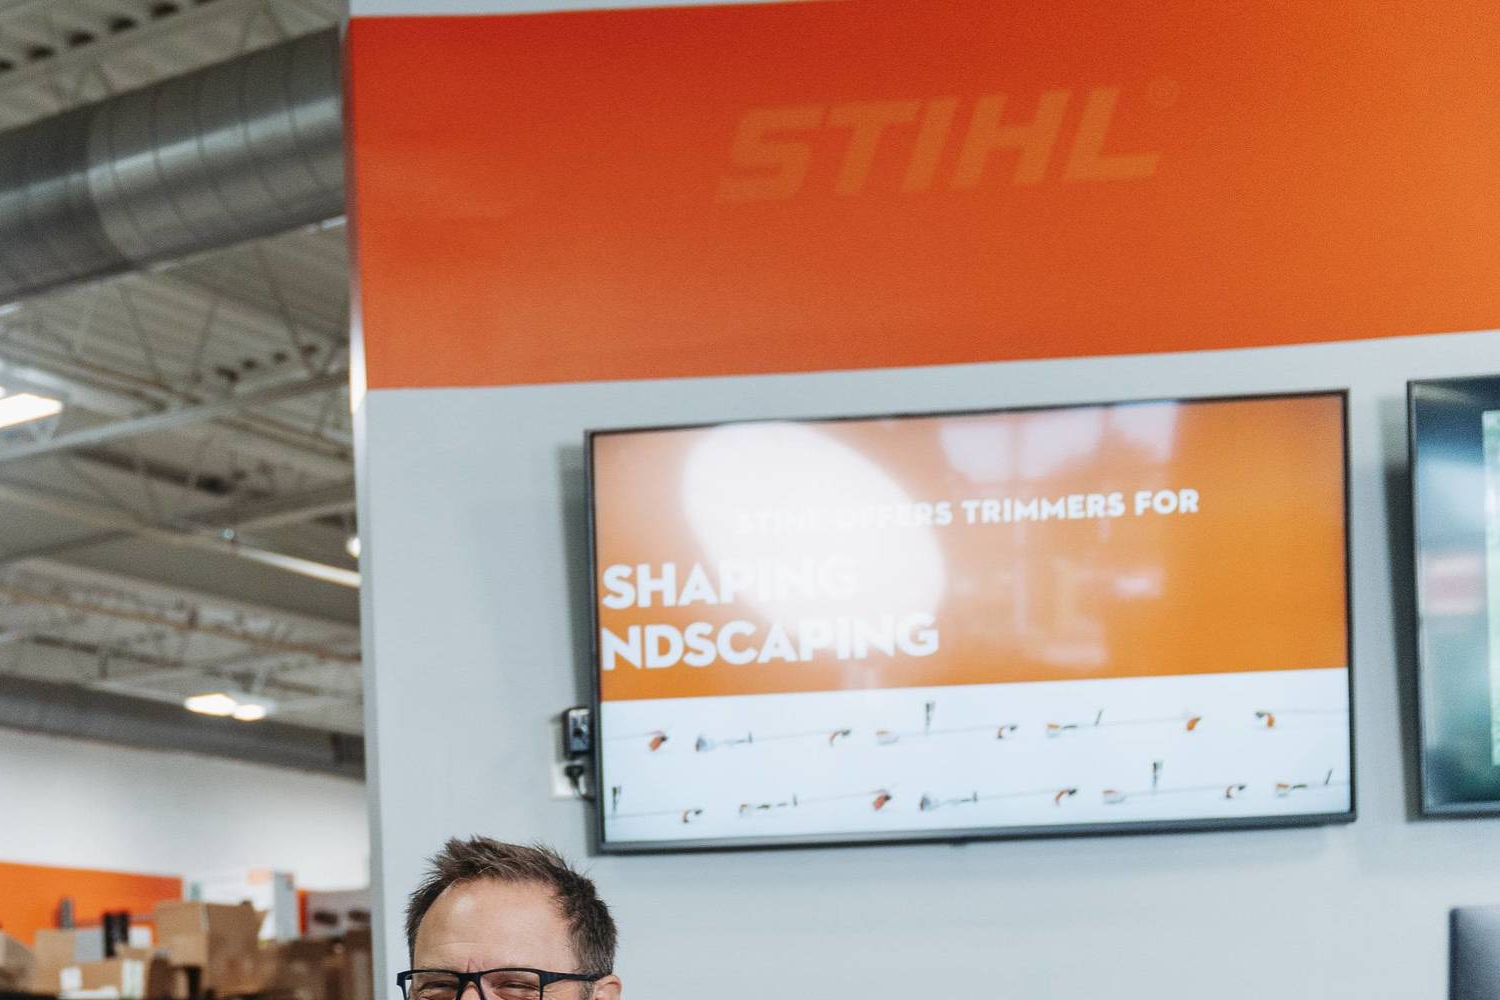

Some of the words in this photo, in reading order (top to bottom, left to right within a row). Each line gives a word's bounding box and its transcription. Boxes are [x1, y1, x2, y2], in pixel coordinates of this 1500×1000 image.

[713, 86, 1161, 204] STIHL
[961, 492, 1126, 524] TRIMMERS
[1134, 488, 1200, 516] FOR
[602, 554, 859, 611] SHAPING
